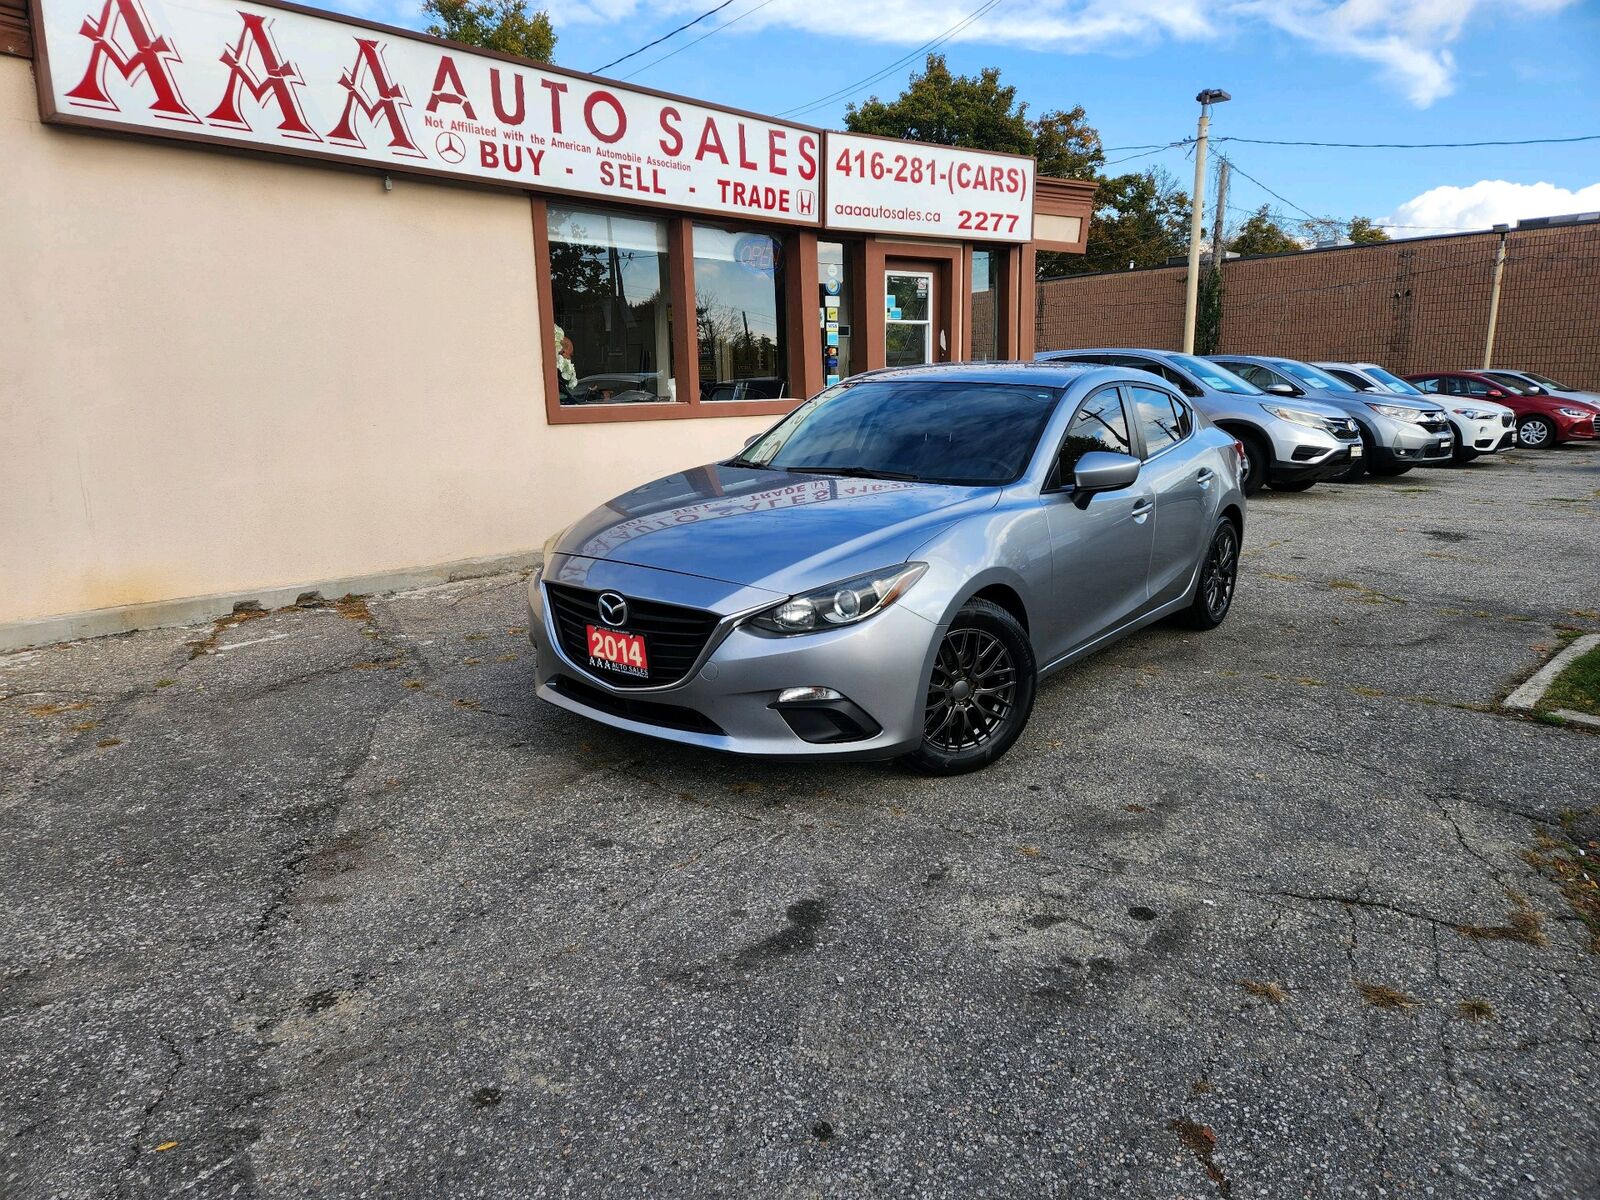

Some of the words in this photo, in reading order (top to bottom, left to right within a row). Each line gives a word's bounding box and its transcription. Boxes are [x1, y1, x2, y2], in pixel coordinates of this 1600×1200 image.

[425, 55, 627, 144] AUTO
[658, 106, 817, 181] SALES
[424, 115, 444, 129] Not
[450, 119, 497, 138] Affiliated
[502, 129, 525, 143] with
[530, 132, 546, 146] the
[551, 137, 592, 154] American
[596, 146, 642, 164] Automobile
[646, 155, 692, 172] Association
[479, 140, 545, 176] BUY
[599, 161, 667, 196] SELL
[717, 179, 790, 213] TRADE
[835, 147, 1027, 202] 416-281-(CARS)
[834, 202, 941, 223] aaaautosales.ca
[957, 209, 1020, 234] 2277
[589, 656, 611, 671] AAA
[611, 662, 628, 672] AUTO
[591, 632, 643, 667] 2014
